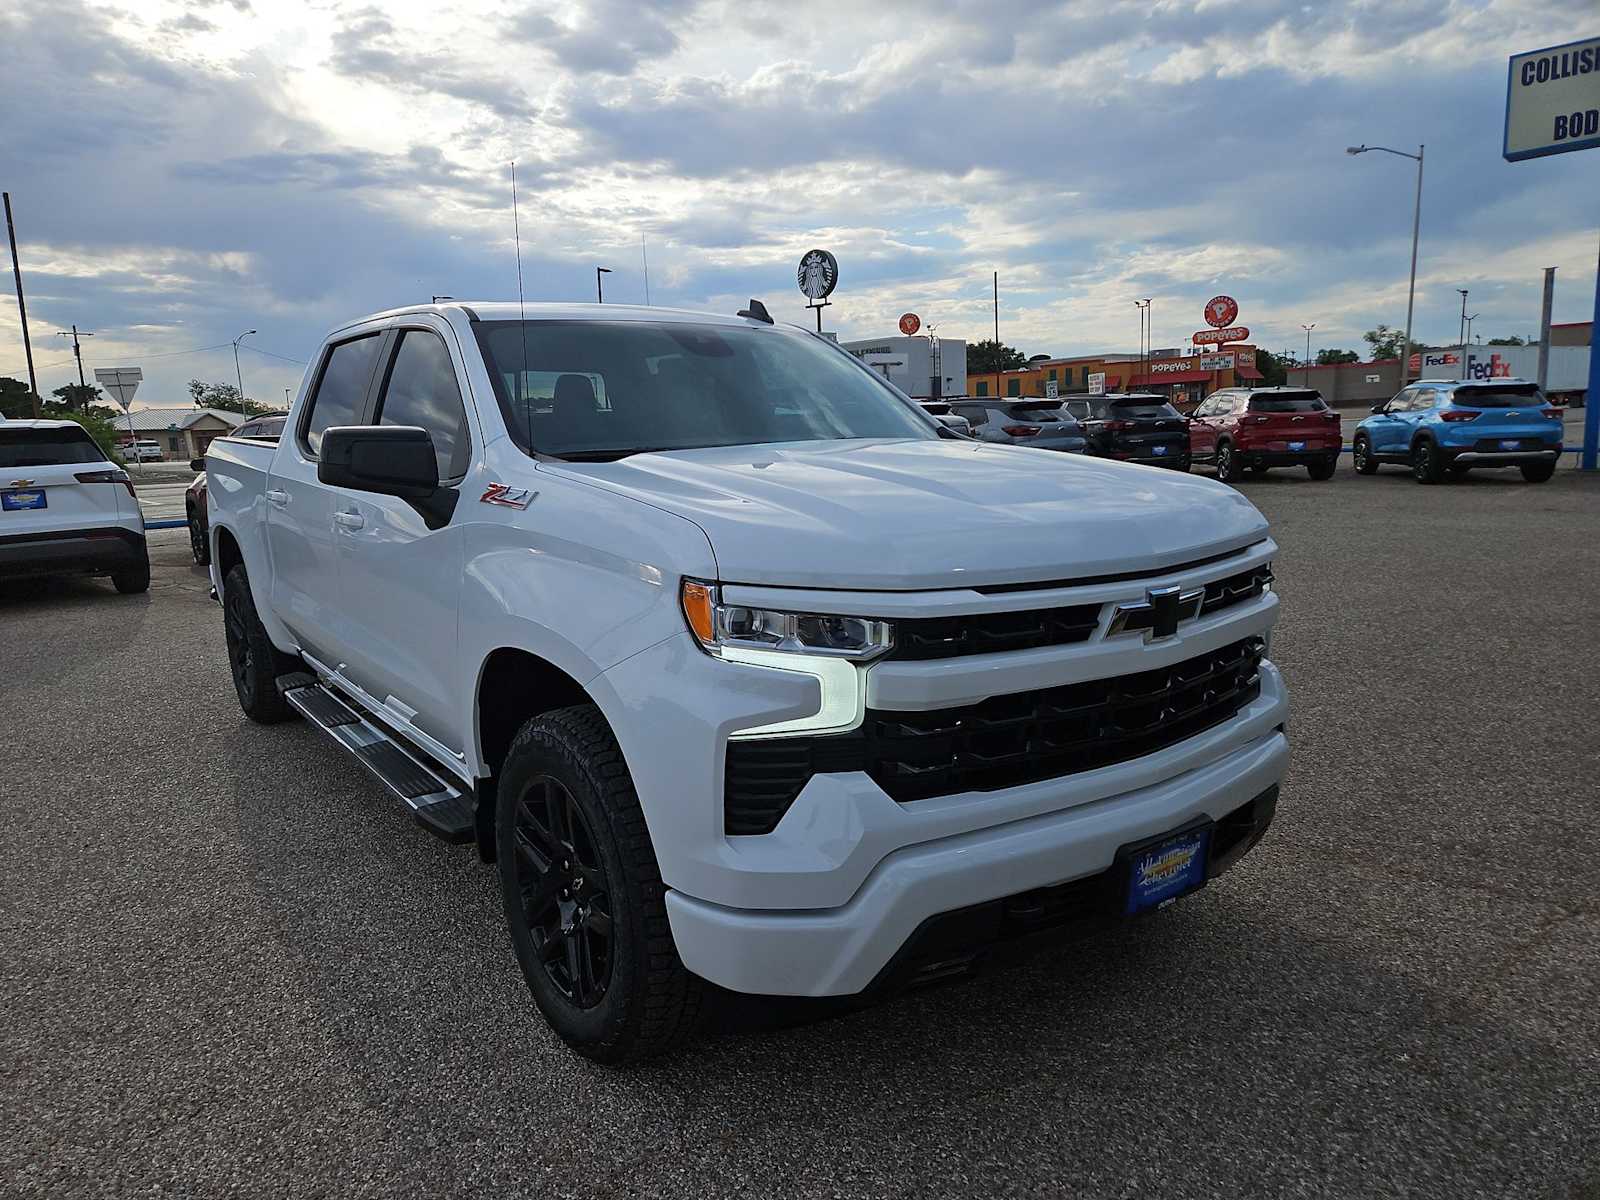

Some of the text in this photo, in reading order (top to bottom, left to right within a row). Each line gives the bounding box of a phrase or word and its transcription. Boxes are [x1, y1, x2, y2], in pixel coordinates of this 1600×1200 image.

[1553, 109, 1599, 140] BOD
[1197, 328, 1243, 343] POPEYES
[1151, 361, 1191, 372] POPEYES
[1425, 353, 1460, 366] FedEx
[1467, 353, 1511, 380] FedEx
